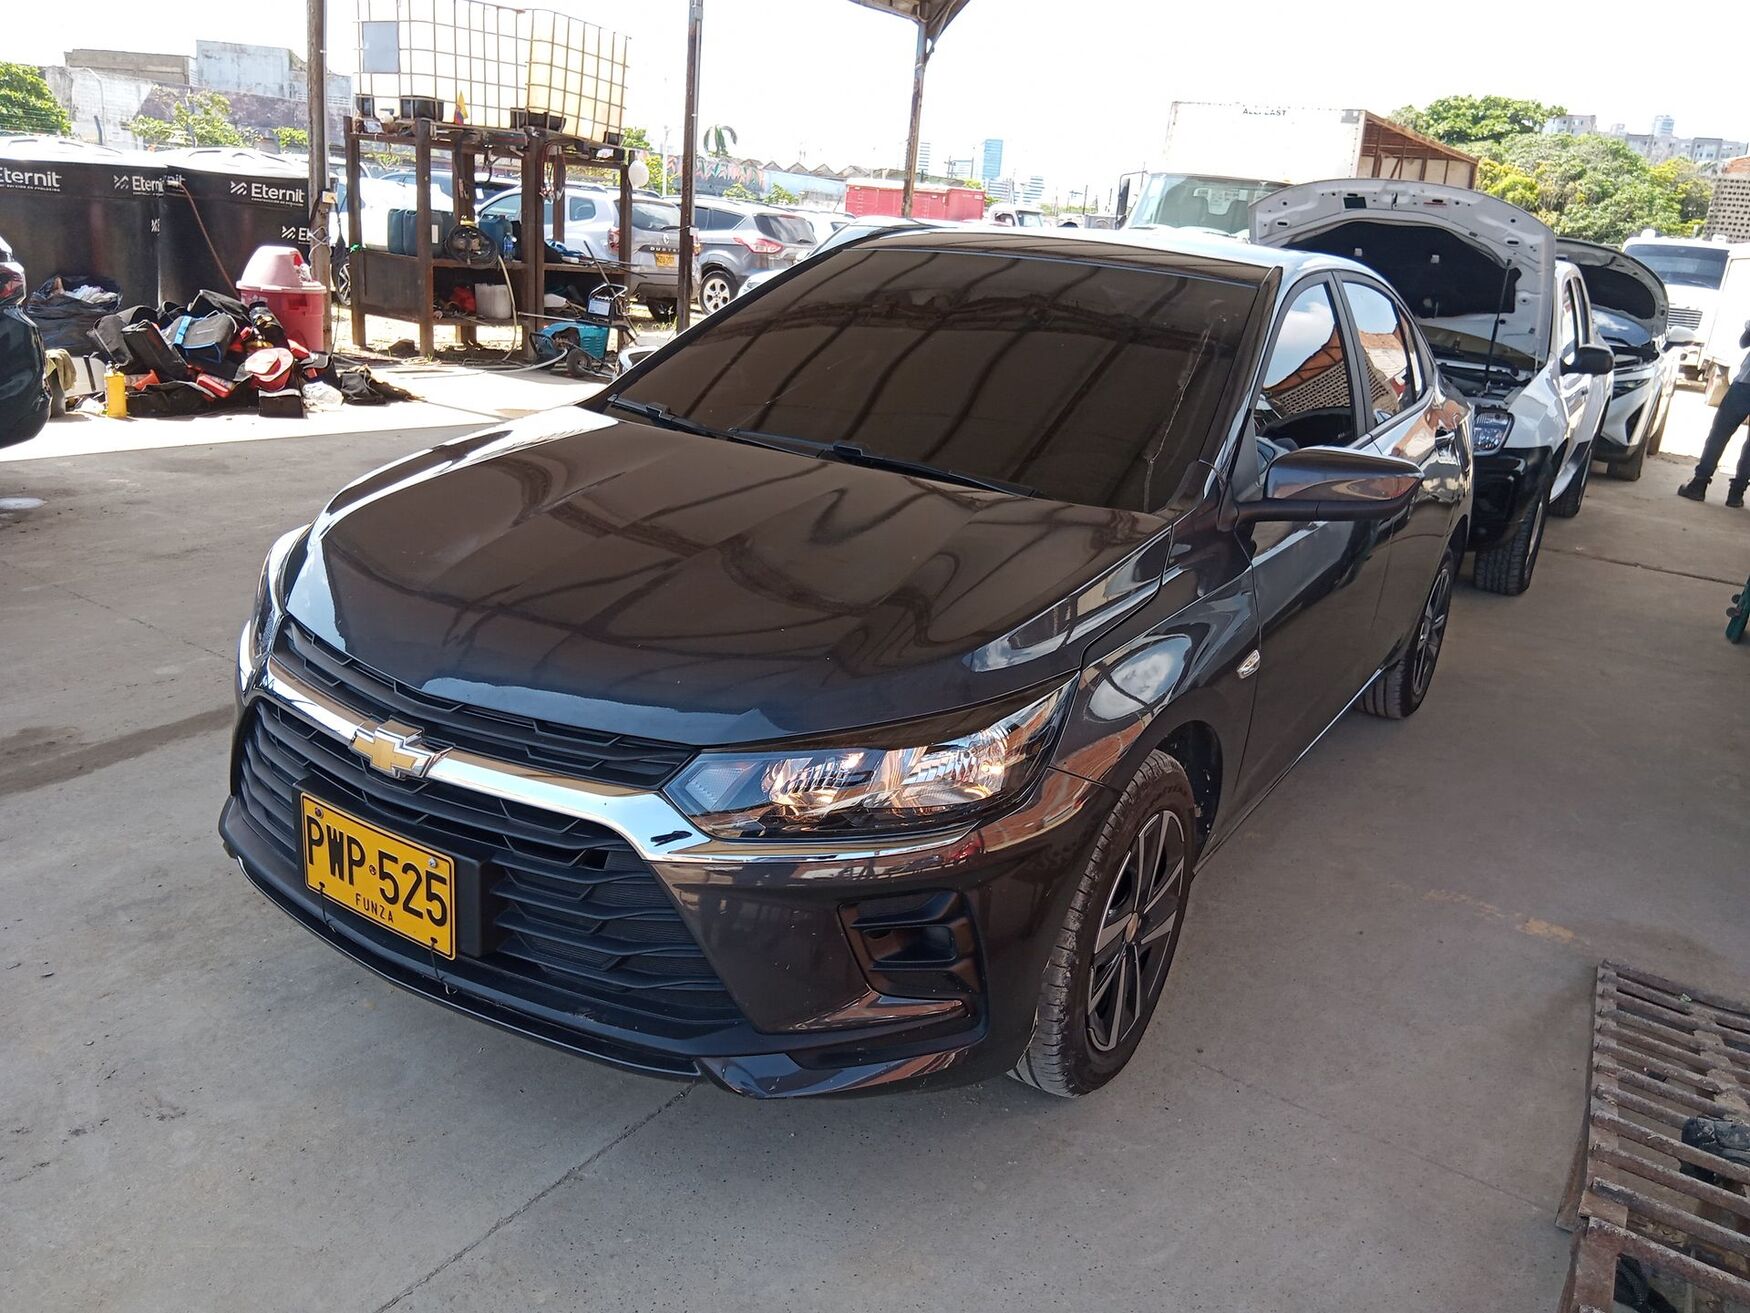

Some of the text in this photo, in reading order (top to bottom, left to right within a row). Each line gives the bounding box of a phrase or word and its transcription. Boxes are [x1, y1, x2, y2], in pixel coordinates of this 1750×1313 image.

[251, 183, 306, 203] Eternit
[306, 815, 448, 927] PWP 525
[355, 892, 394, 923] FUNZA
